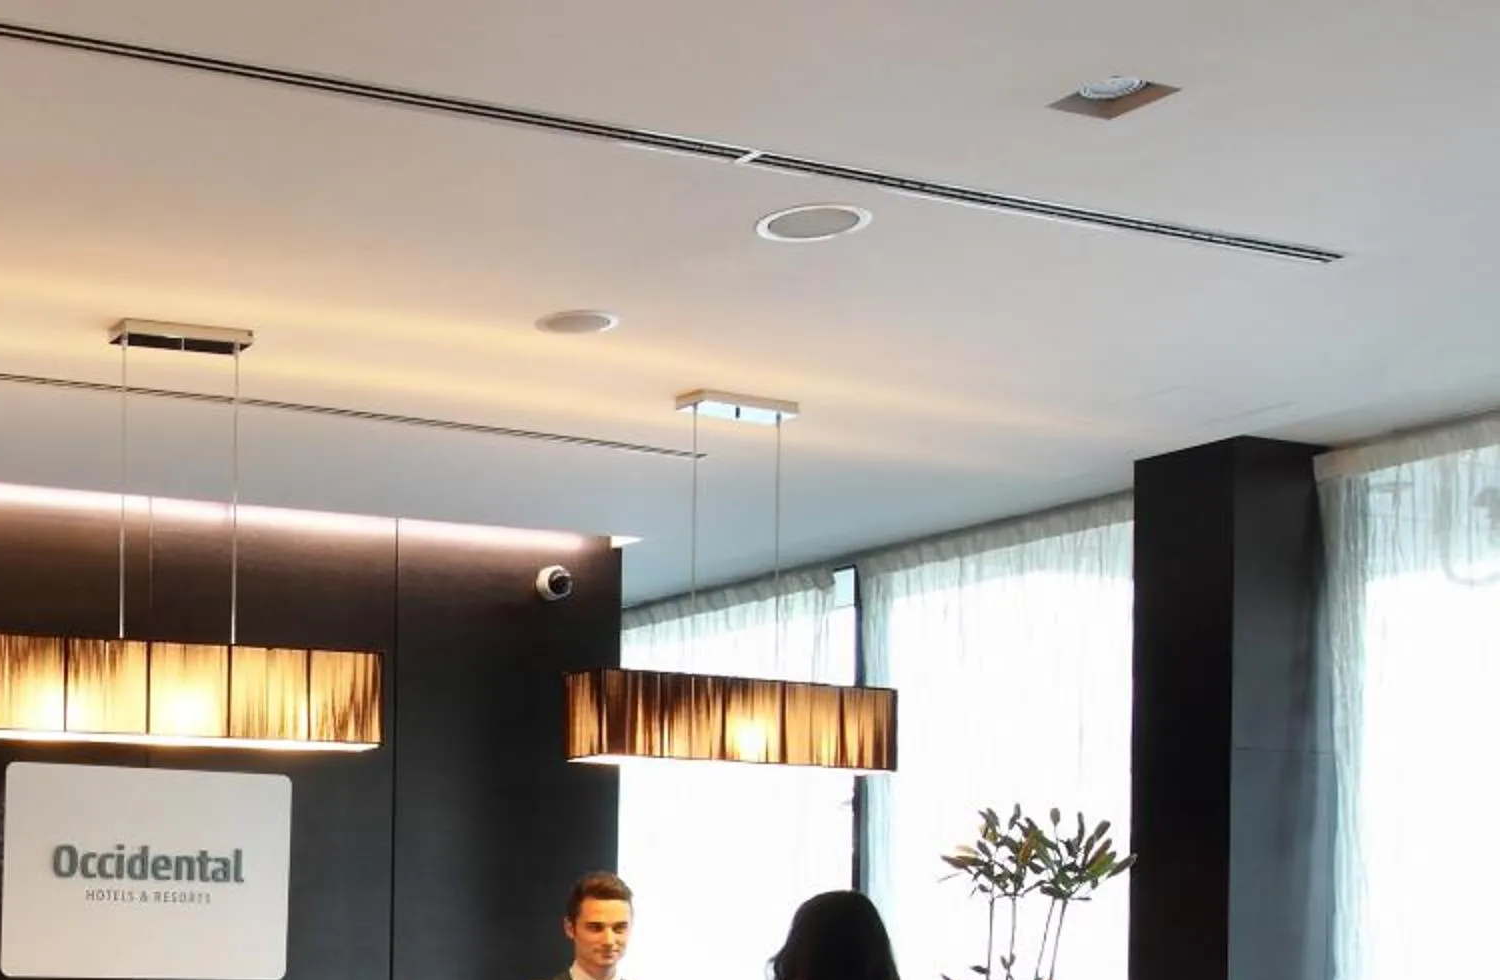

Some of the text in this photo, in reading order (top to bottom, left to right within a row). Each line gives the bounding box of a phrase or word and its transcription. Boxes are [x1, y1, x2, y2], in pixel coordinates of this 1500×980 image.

[52, 843, 245, 884] Occidental
[86, 889, 212, 905] HOTELS & RESORTS
